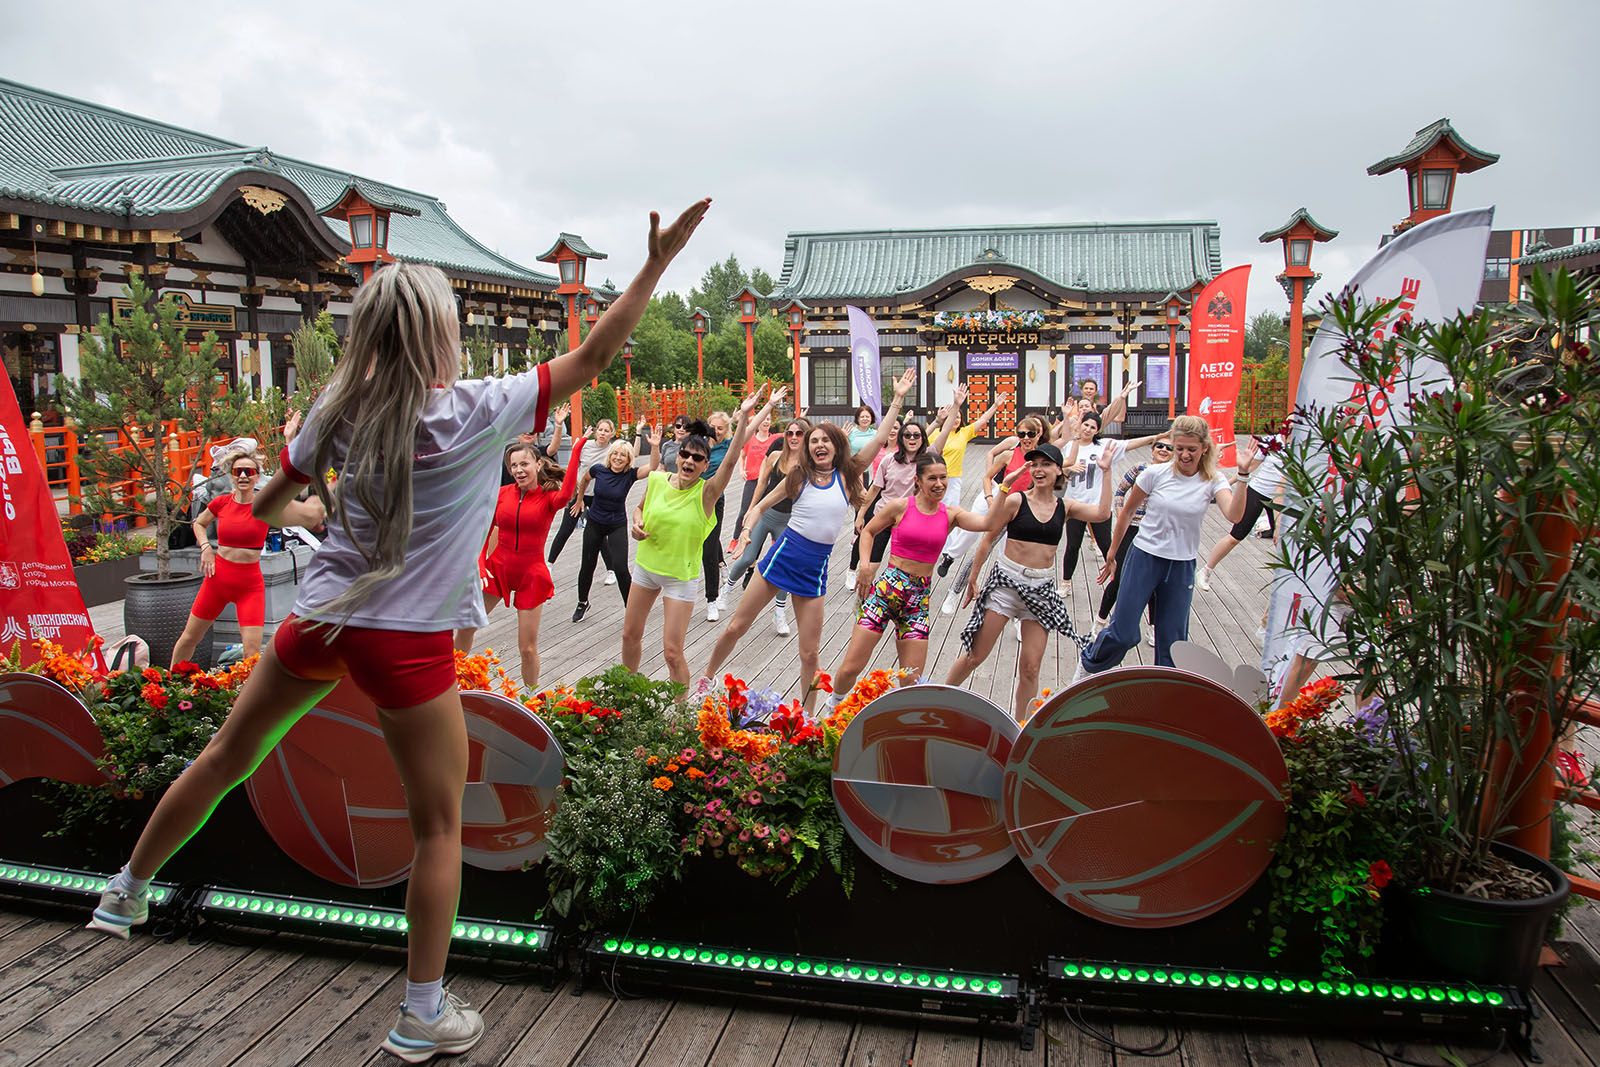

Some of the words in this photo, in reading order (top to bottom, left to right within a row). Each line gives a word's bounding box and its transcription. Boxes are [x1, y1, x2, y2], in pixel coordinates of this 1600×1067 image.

[947, 333, 1039, 345] АКТЕРСКАЯ
[1200, 361, 1235, 373] ЛЕТО
[27, 613, 90, 627] МОСКОВСКИЙ
